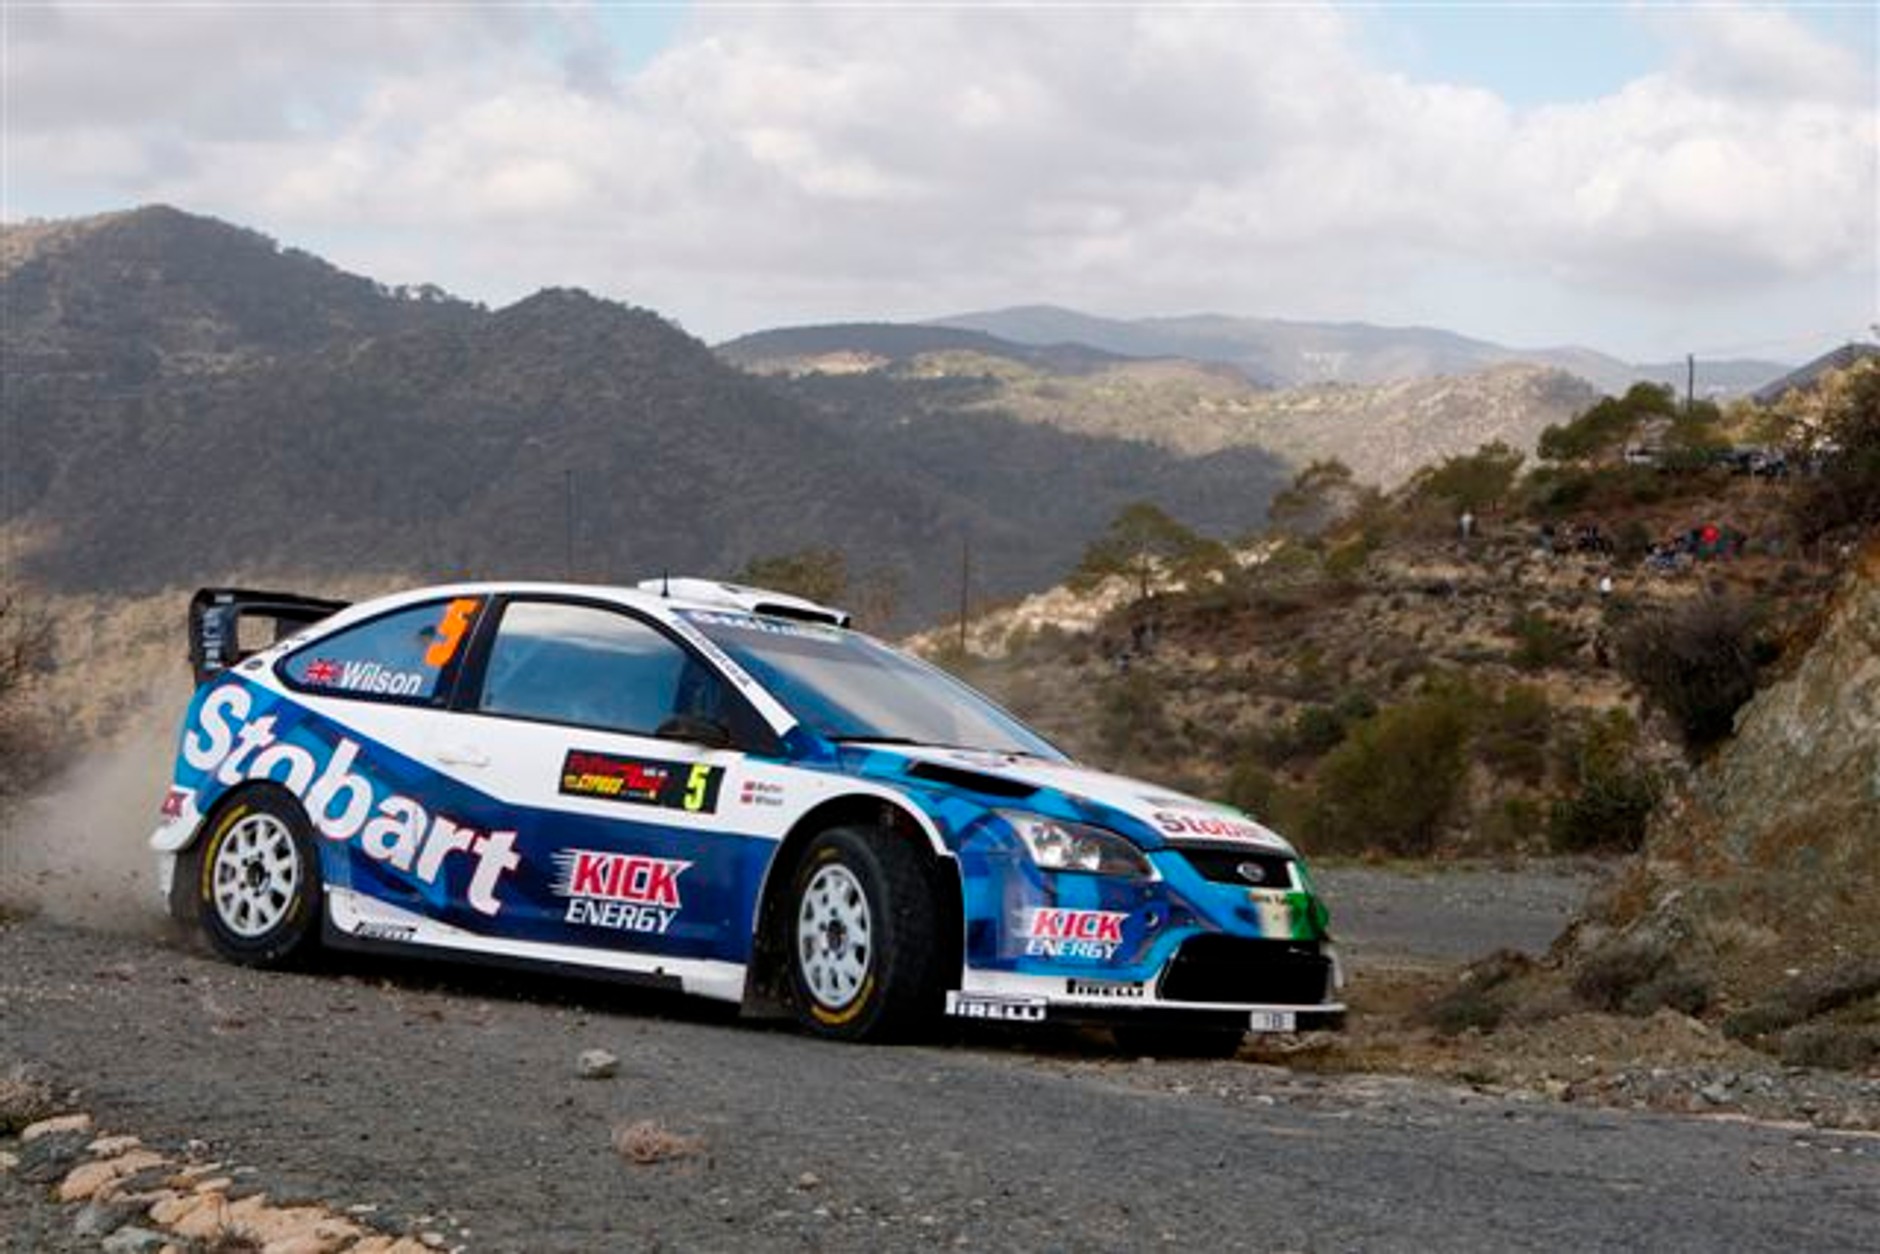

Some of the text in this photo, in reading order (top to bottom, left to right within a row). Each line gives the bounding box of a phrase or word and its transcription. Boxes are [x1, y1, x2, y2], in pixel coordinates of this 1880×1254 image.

[424, 599, 478, 668] 5
[340, 661, 423, 695] Wilson
[183, 683, 521, 916] Stobart
[683, 762, 711, 813] 5
[568, 851, 690, 909] KICK
[564, 898, 677, 934] ENERGY
[1032, 908, 1128, 943] KICK
[1024, 940, 1117, 959] ENERGY
[945, 990, 1047, 1021] PIRELLI
[1066, 978, 1144, 998] PIRELLI
